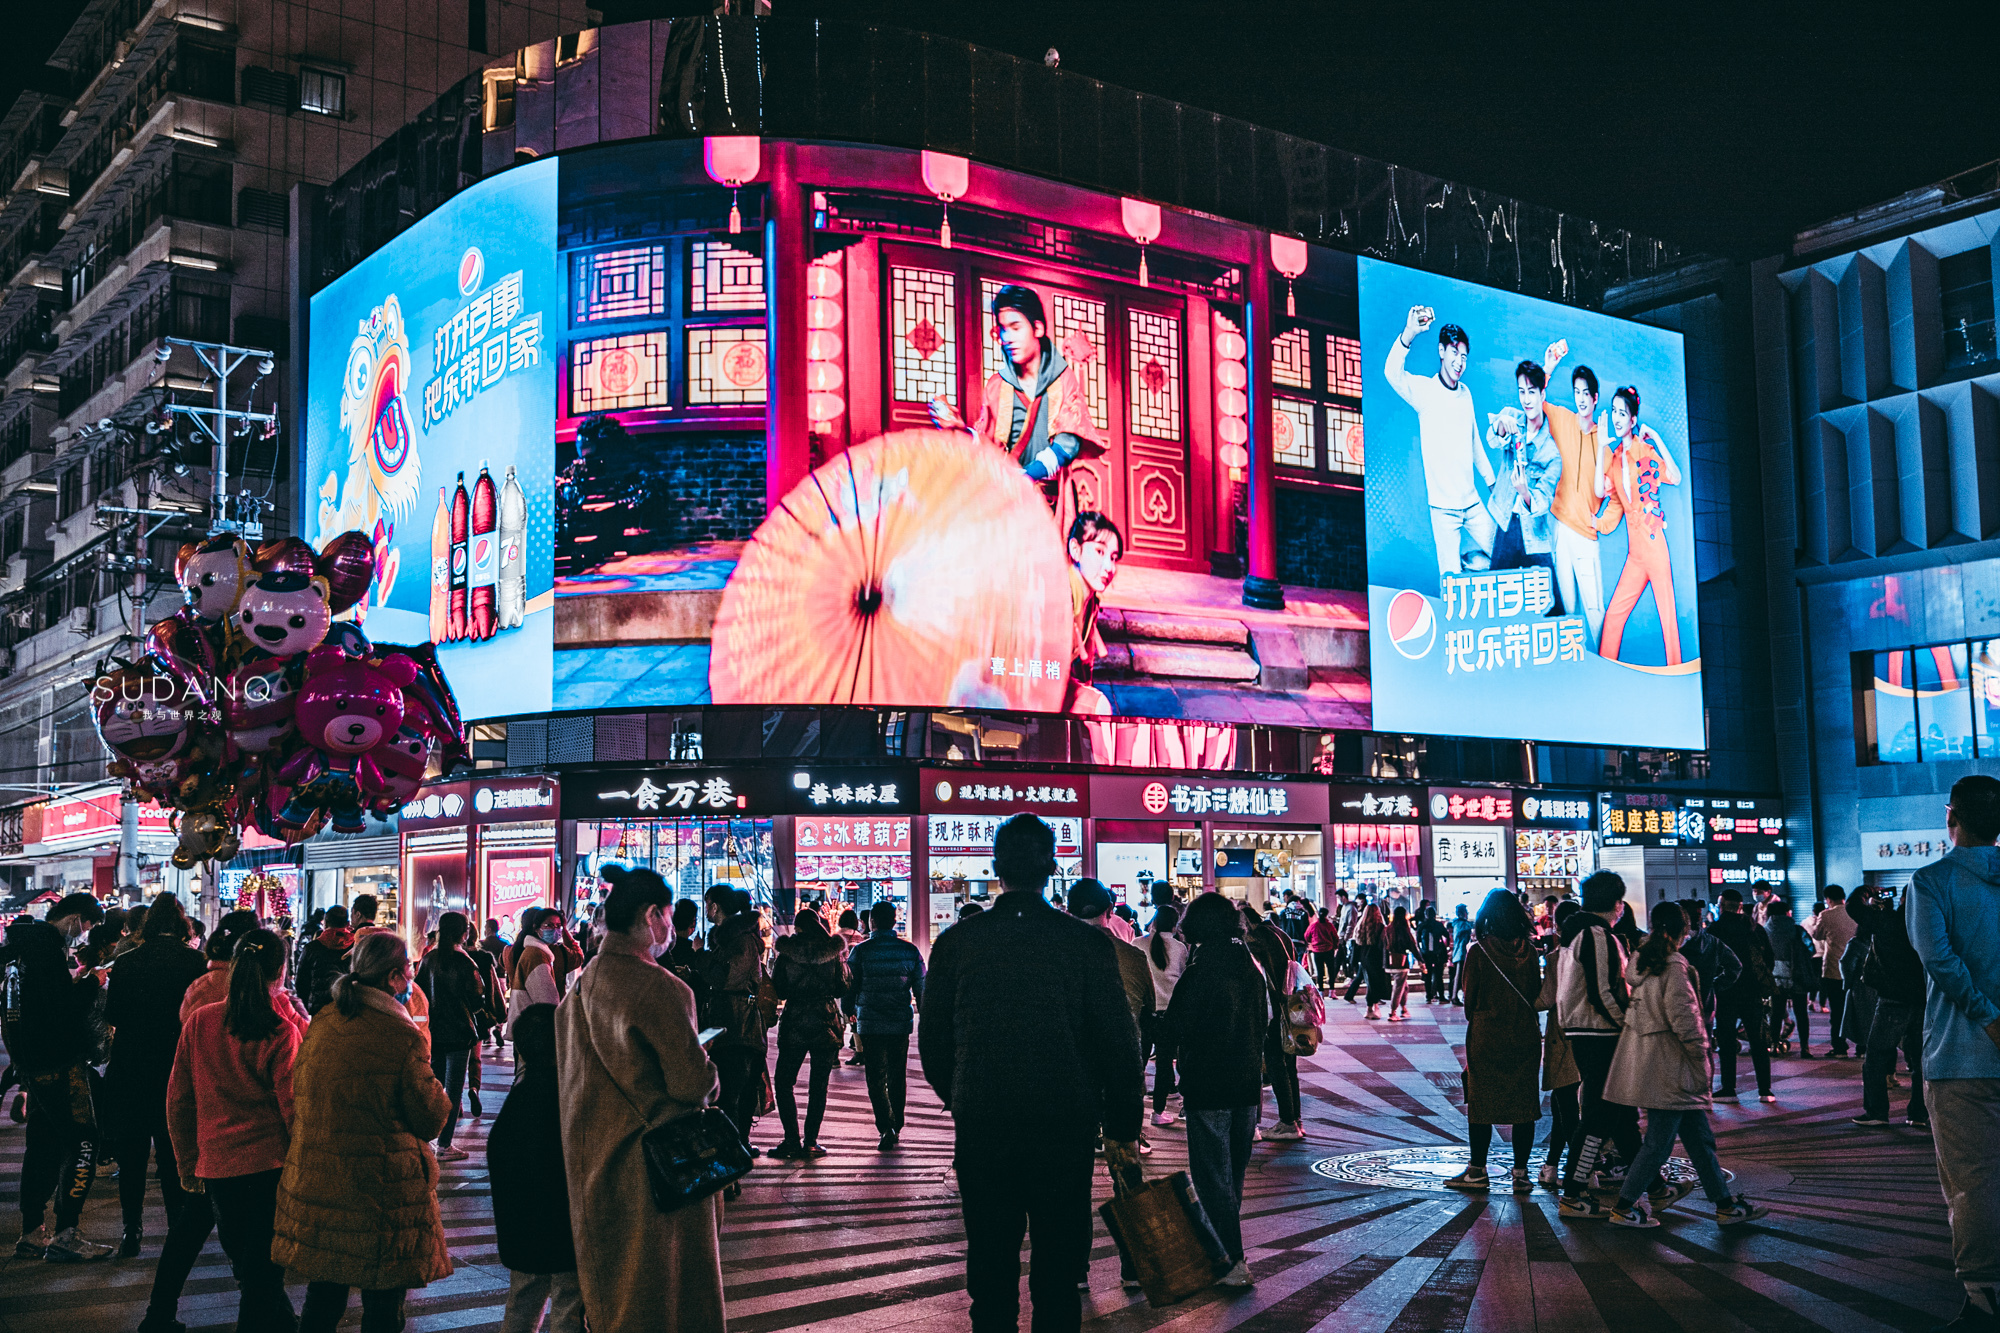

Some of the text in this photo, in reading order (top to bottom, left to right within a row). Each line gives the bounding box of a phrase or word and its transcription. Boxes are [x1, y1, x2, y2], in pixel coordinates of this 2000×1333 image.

[435, 276, 521, 373] 打开百事
[423, 317, 540, 430] 把乐带回家
[1442, 570, 1552, 622] 打开百事
[1444, 617, 1586, 675] 把乐带回家
[990, 656, 1061, 680] 喜上眉梢
[598, 776, 737, 810] 一食万巷
[1169, 784, 1289, 816] 书亦烧仙草
[1342, 792, 1414, 817] 一食万巷
[1448, 793, 1514, 821] 串世魔王
[833, 820, 911, 847] 冰糖葫芦
[935, 820, 995, 843] 现炸酥肉
[1610, 808, 1676, 834] 银座造型
[1459, 840, 1496, 859] 雪梨汤
[1572, 1134, 1603, 1184] PUMA
